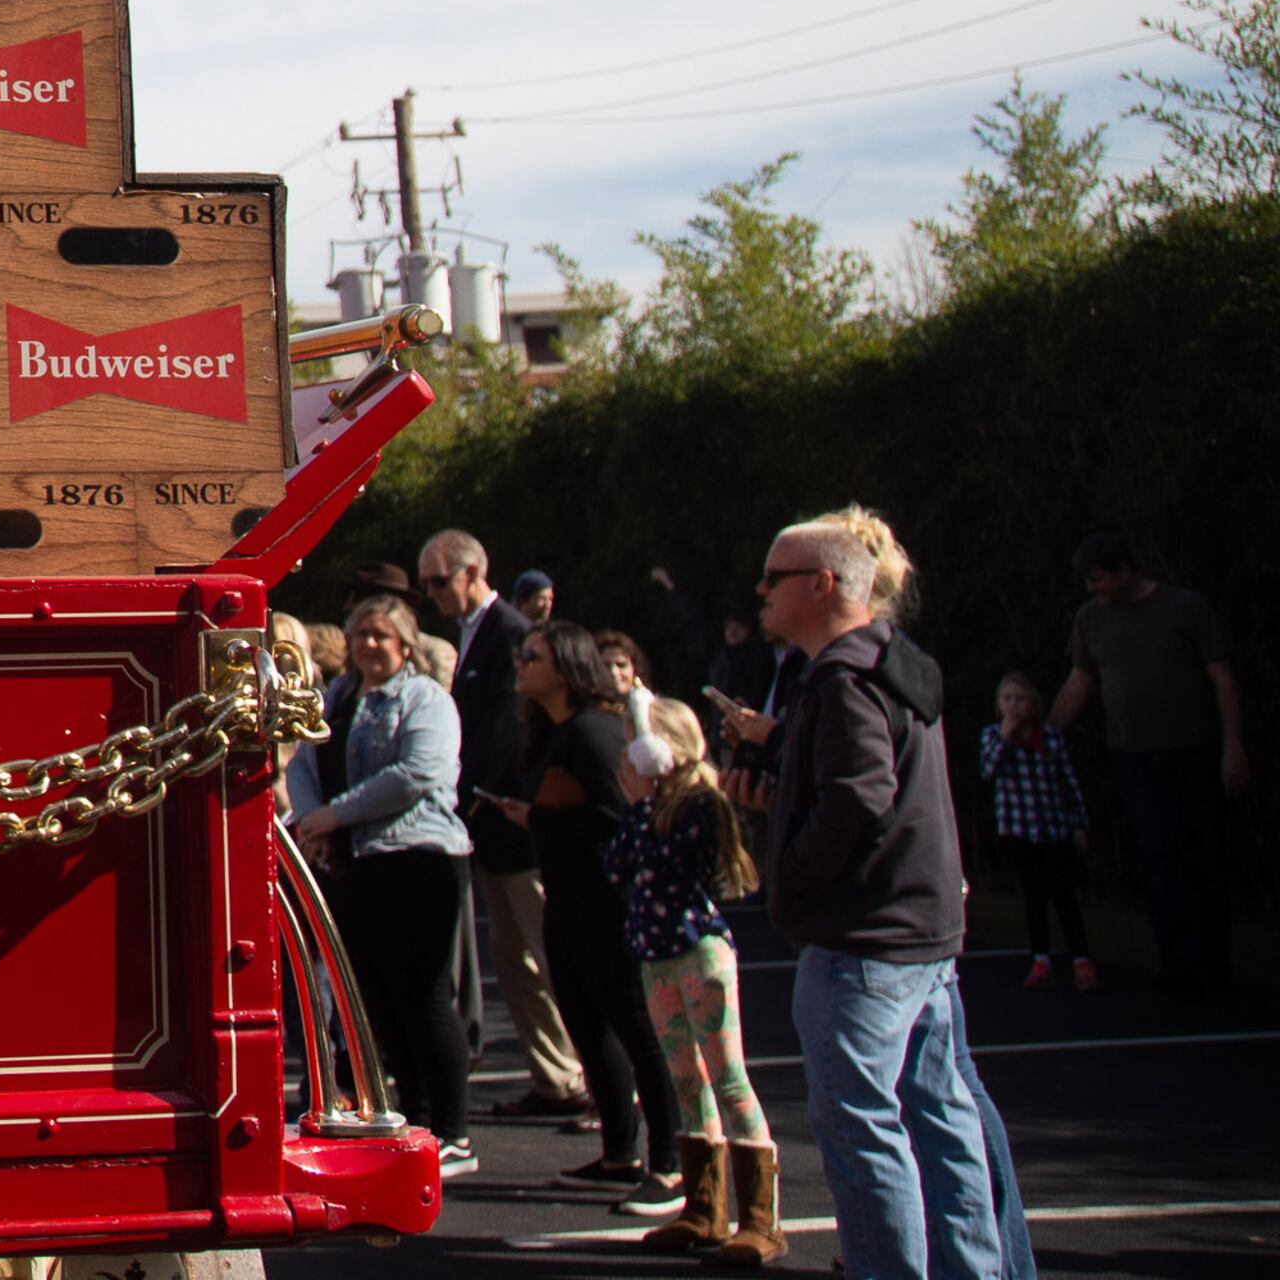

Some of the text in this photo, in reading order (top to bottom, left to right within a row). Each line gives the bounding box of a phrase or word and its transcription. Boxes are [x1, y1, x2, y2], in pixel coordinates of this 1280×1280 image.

[179, 205, 258, 224] 1876
[17, 340, 235, 379] Budweiser
[42, 483, 124, 507] 1876
[156, 483, 235, 505] SINCE
